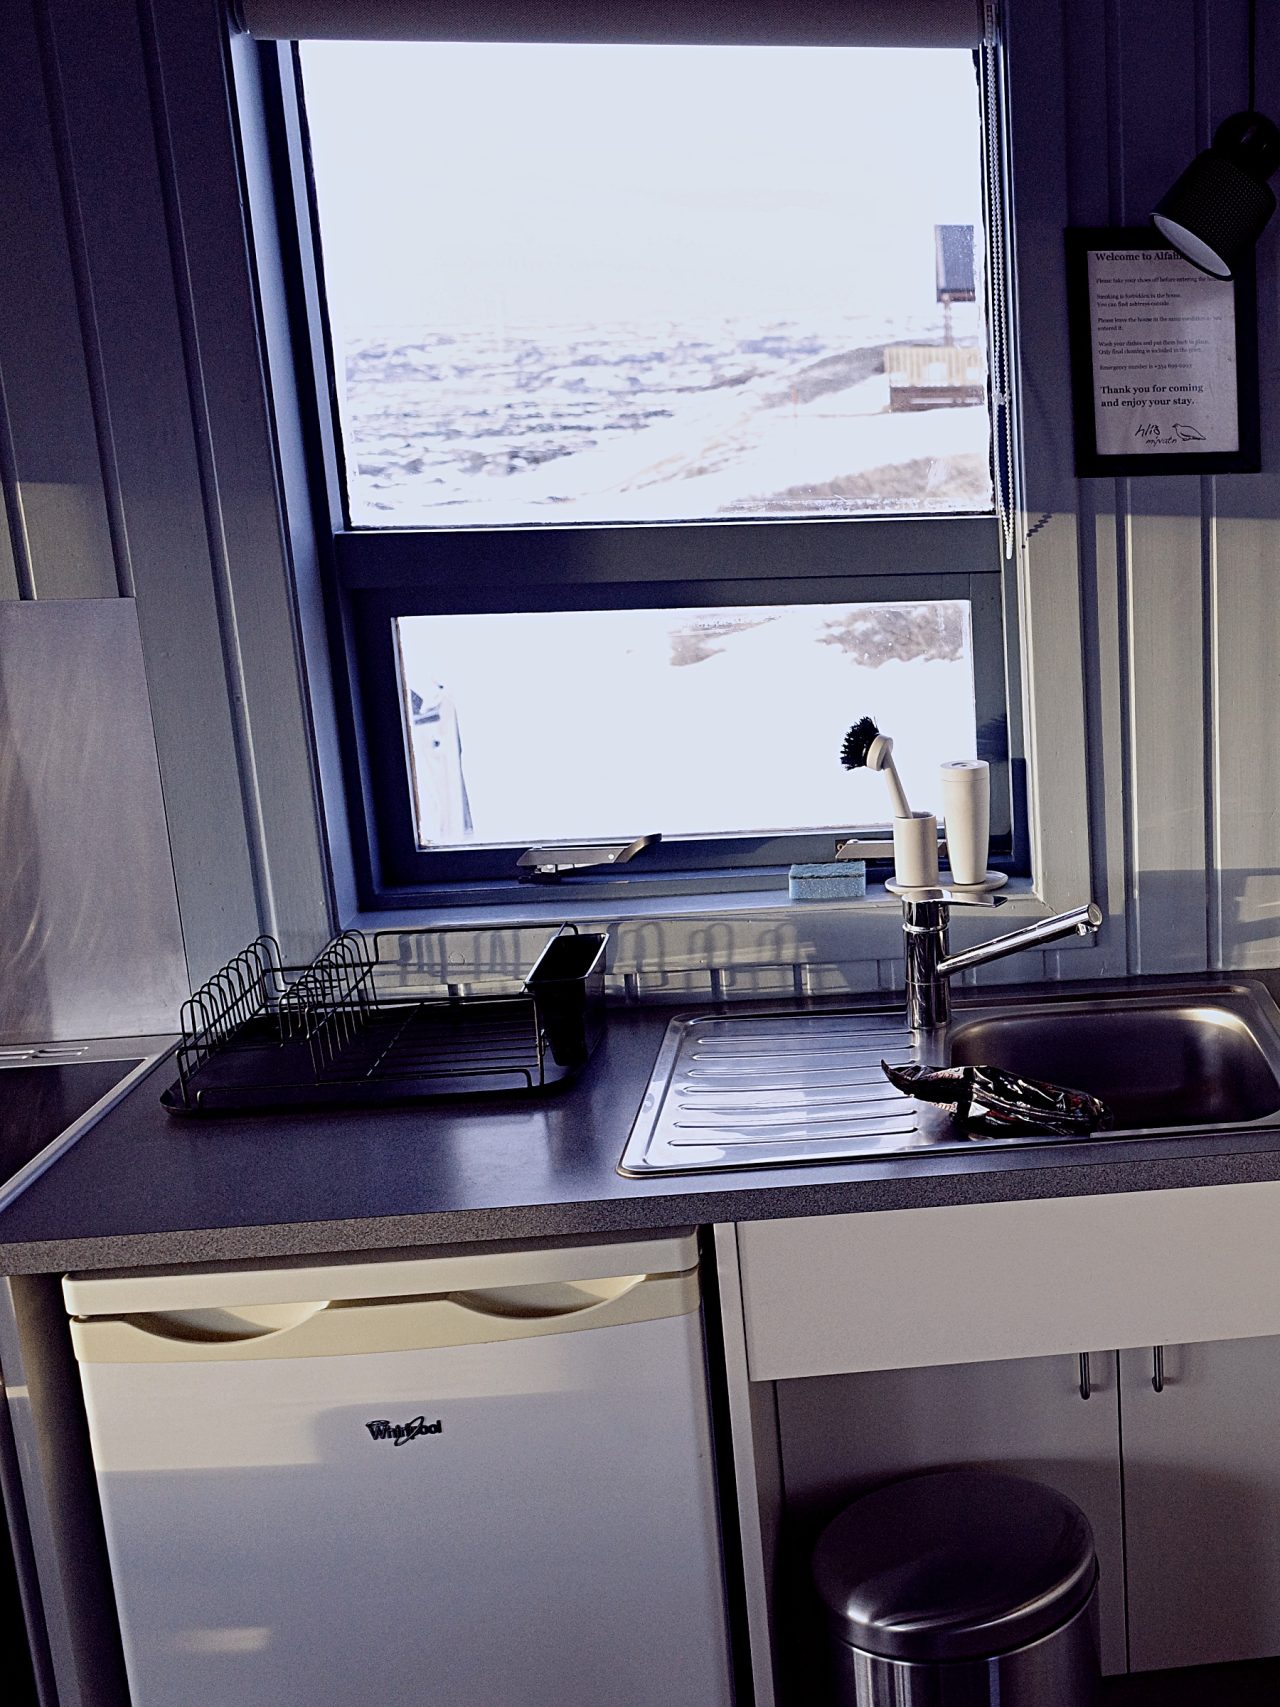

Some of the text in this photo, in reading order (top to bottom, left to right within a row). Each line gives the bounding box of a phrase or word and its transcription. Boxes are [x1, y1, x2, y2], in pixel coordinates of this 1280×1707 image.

[1096, 252, 1140, 261] Welcome
[1142, 252, 1152, 260] to
[1101, 383, 1204, 395] Thank you for coming
[1101, 397, 1195, 409] and enjoy your stay.
[365, 1416, 443, 1446] Whirlpool
